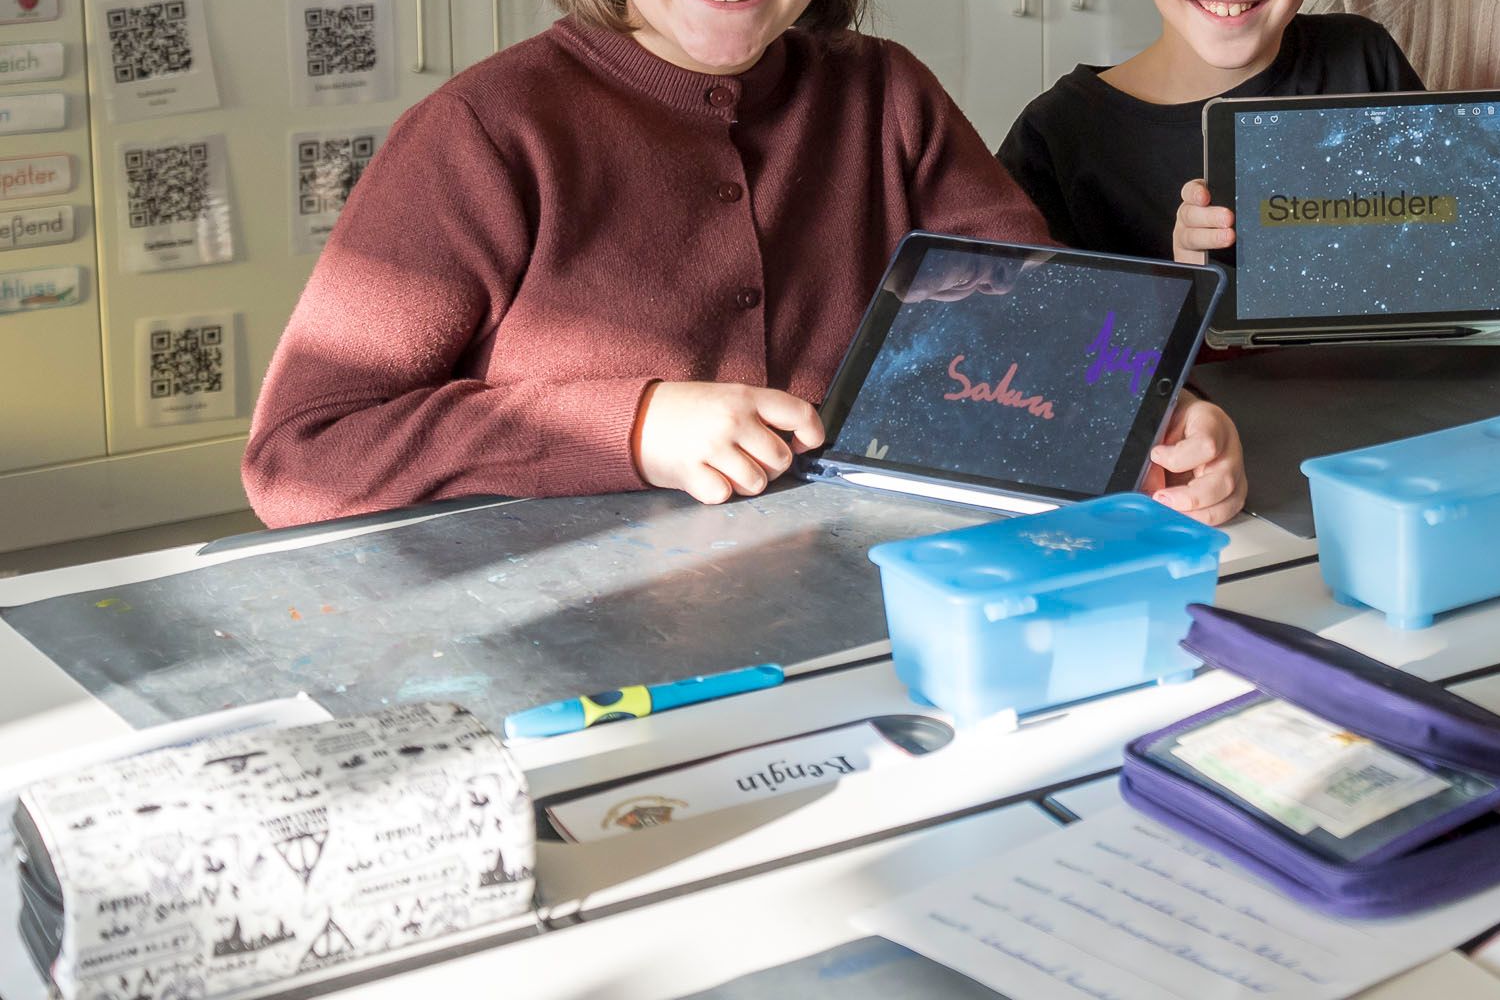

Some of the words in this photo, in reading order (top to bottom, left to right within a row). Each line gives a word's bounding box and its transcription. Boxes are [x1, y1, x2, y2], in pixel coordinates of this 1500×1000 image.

[0, 163, 56, 194] päter
[1267, 190, 1439, 222] Sternbilder
[735, 755, 856, 792] Rengin
